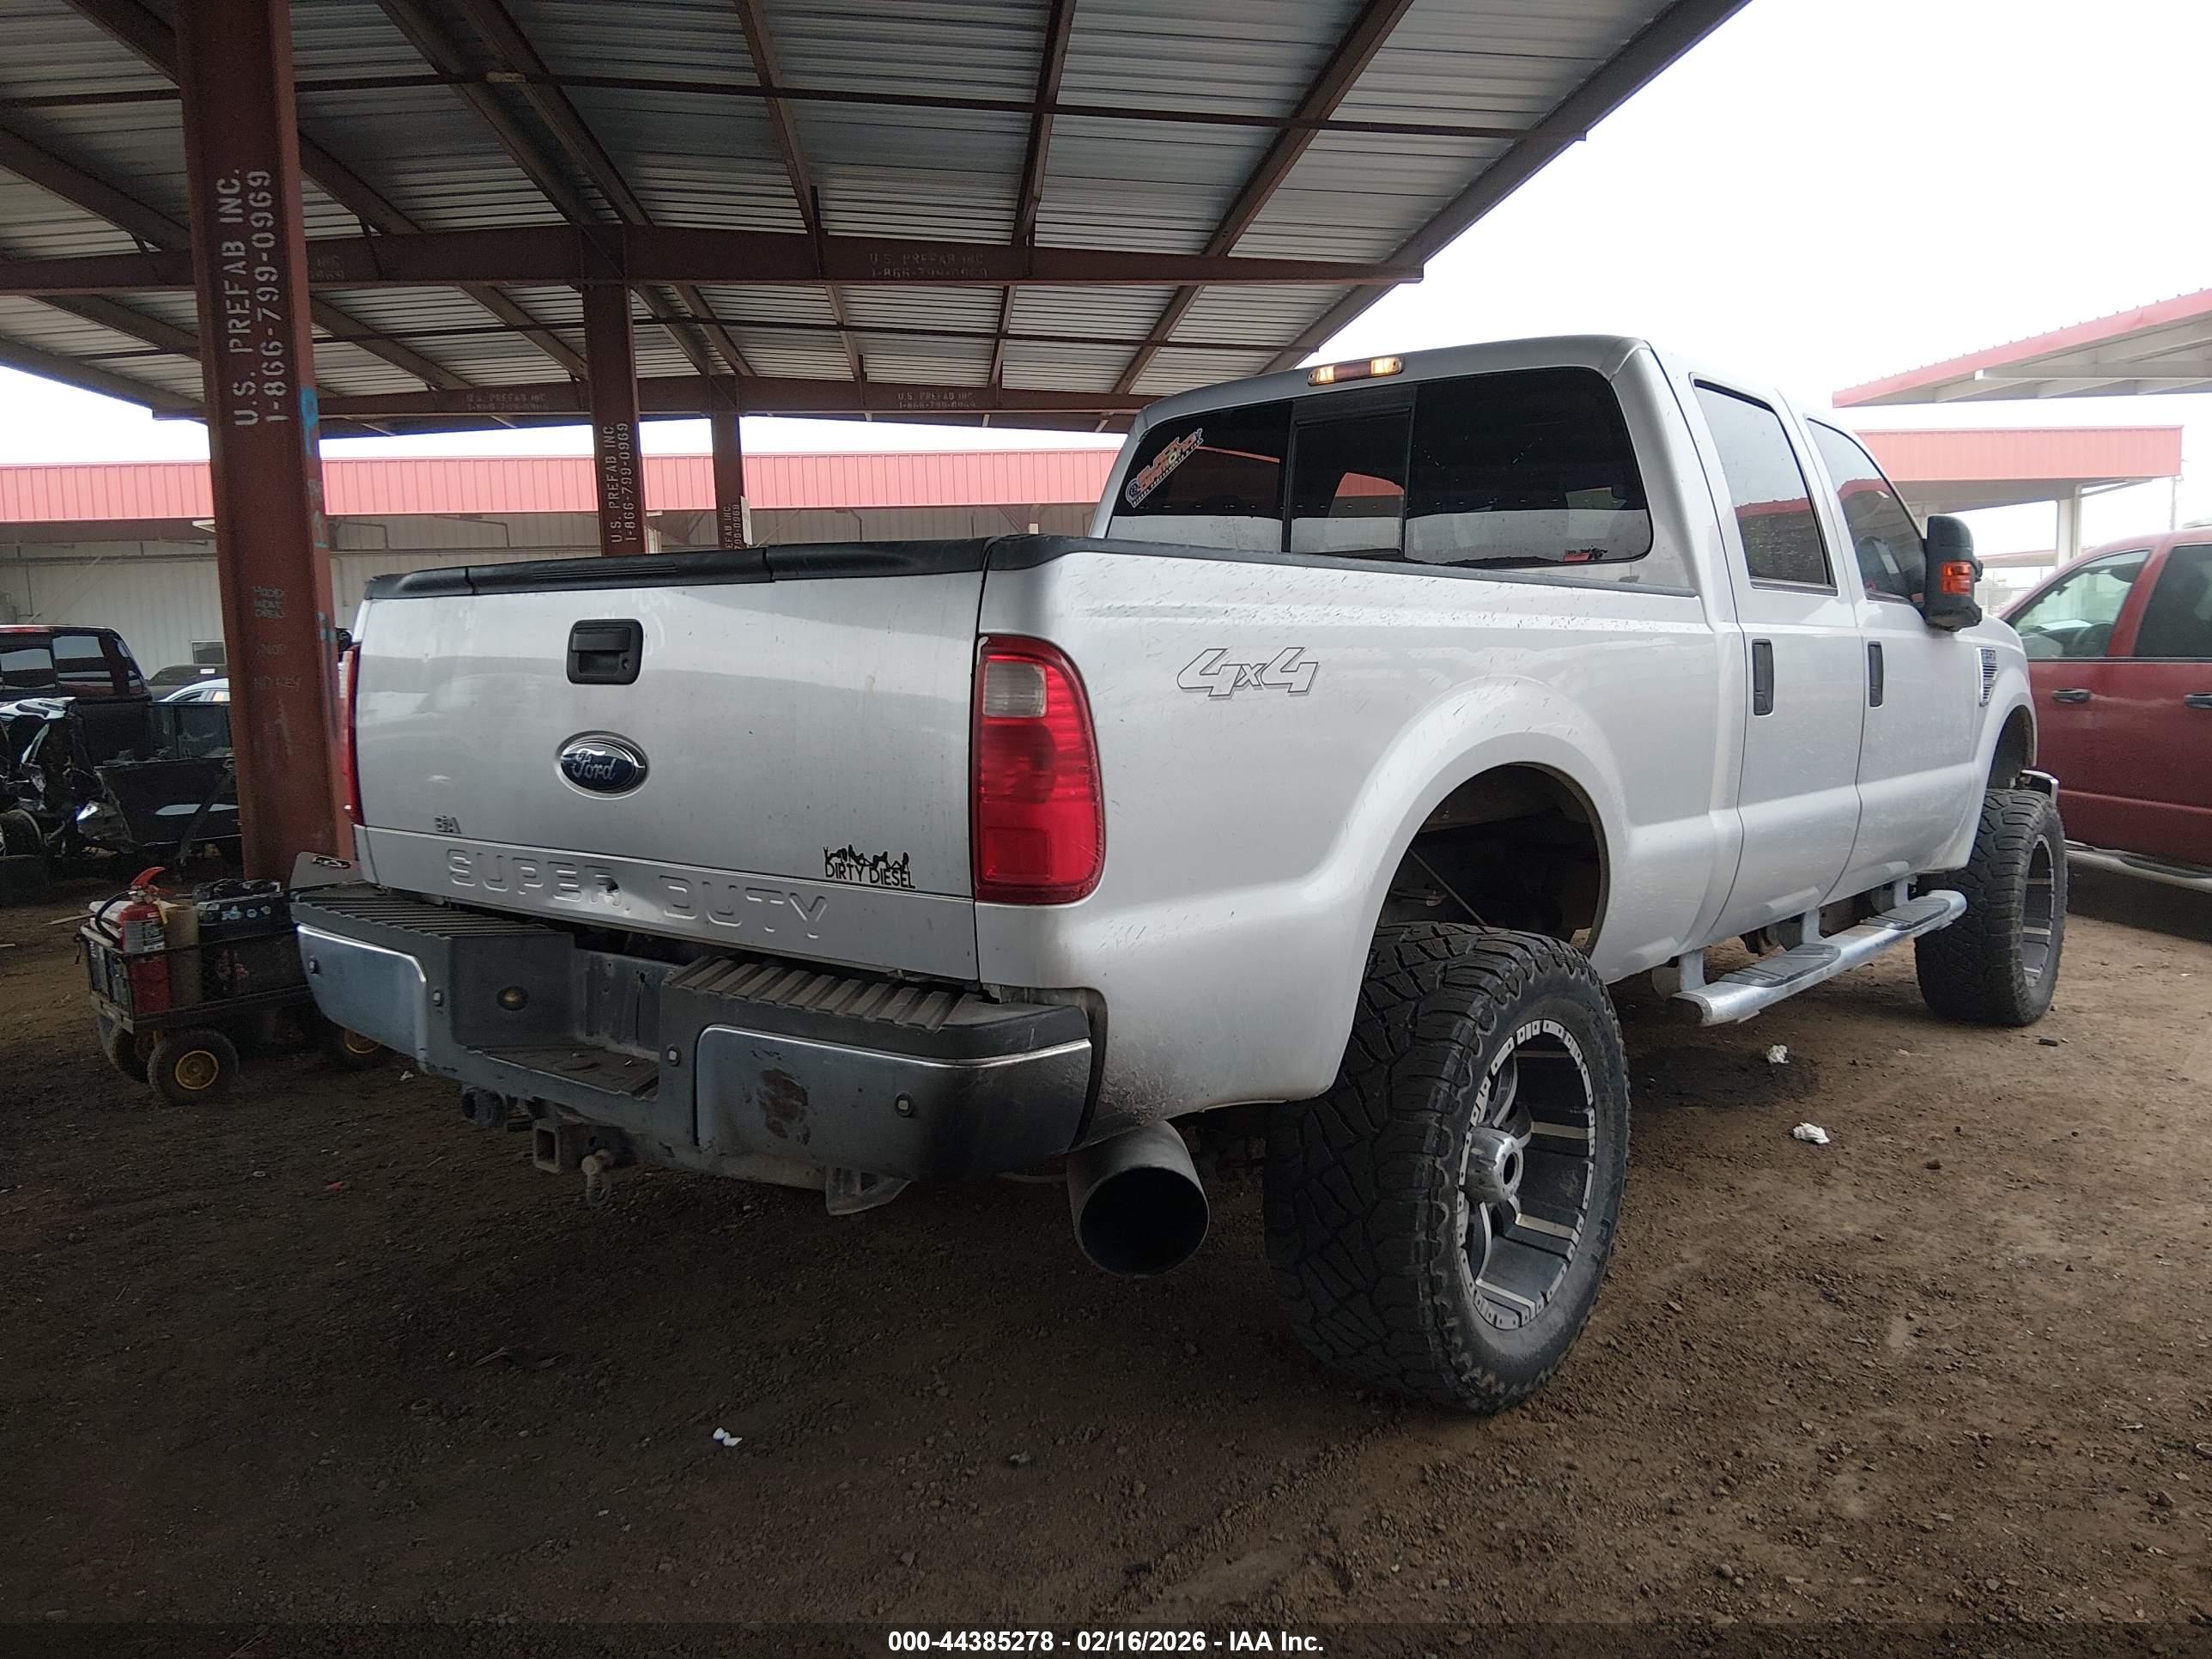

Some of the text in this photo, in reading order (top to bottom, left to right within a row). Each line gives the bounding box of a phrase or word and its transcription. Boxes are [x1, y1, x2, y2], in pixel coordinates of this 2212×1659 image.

[217, 168, 259, 426] U.S. PREFAB INC.
[247, 170, 289, 422] 1-866-799-0969
[605, 456, 620, 509] PREFAB
[1177, 647, 1320, 698] 4x4
[571, 748, 617, 780] Ford
[447, 848, 830, 939] SUPER DUTY
[825, 861, 916, 889] DIRTY DIESEL
